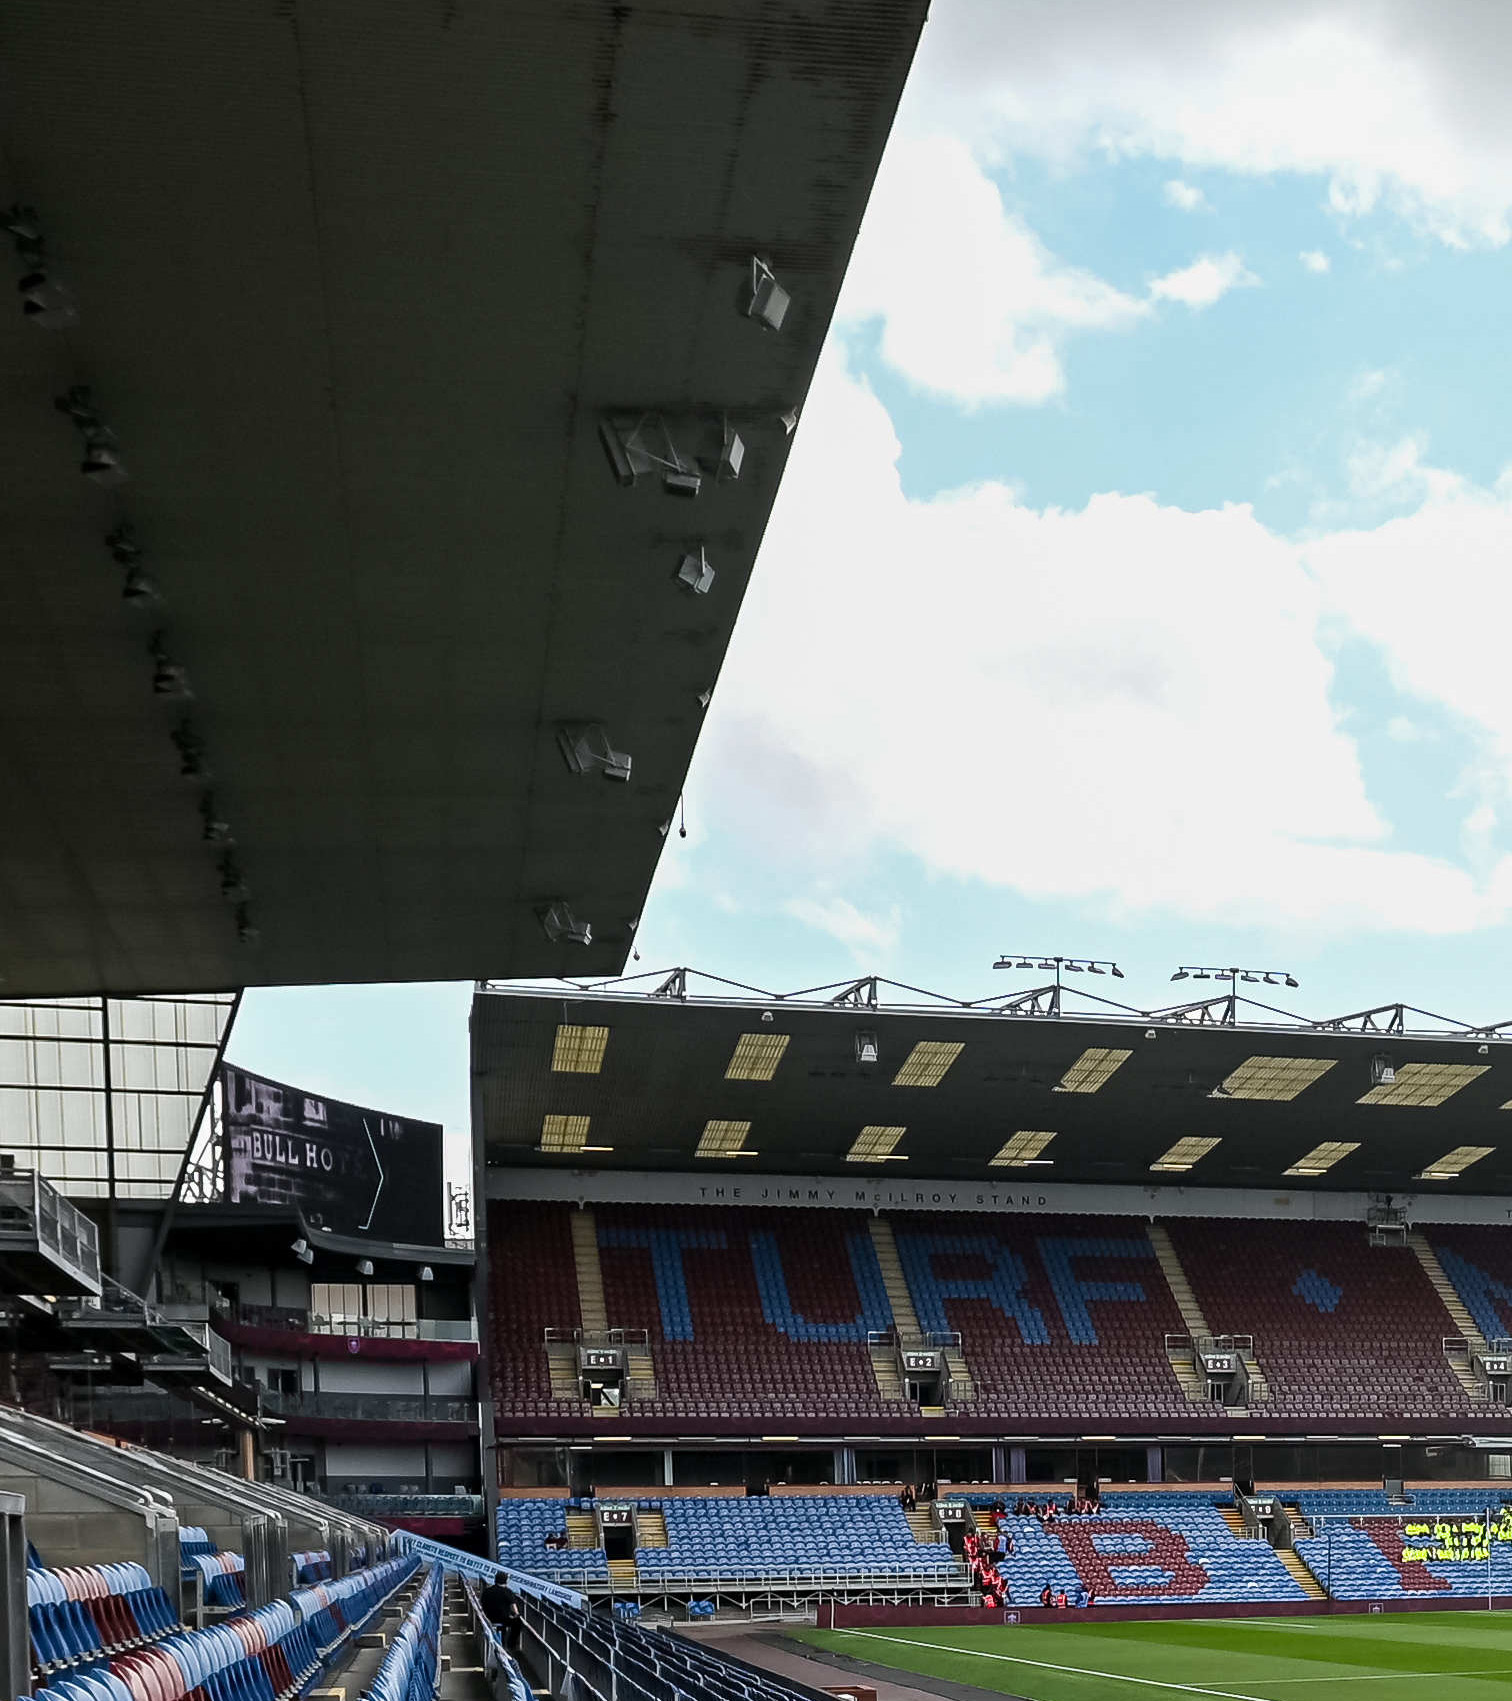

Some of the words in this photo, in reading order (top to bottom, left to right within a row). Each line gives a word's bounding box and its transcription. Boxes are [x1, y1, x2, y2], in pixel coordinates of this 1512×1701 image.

[253, 1132, 298, 1164] BULL
[699, 1187, 742, 1198] THE
[761, 1188, 835, 1201] JIMMY
[855, 1191, 958, 1204] McILROY
[975, 1194, 1047, 1206] STAND
[597, 1226, 1154, 1345] TURF
[1043, 1518, 1210, 1597] B
